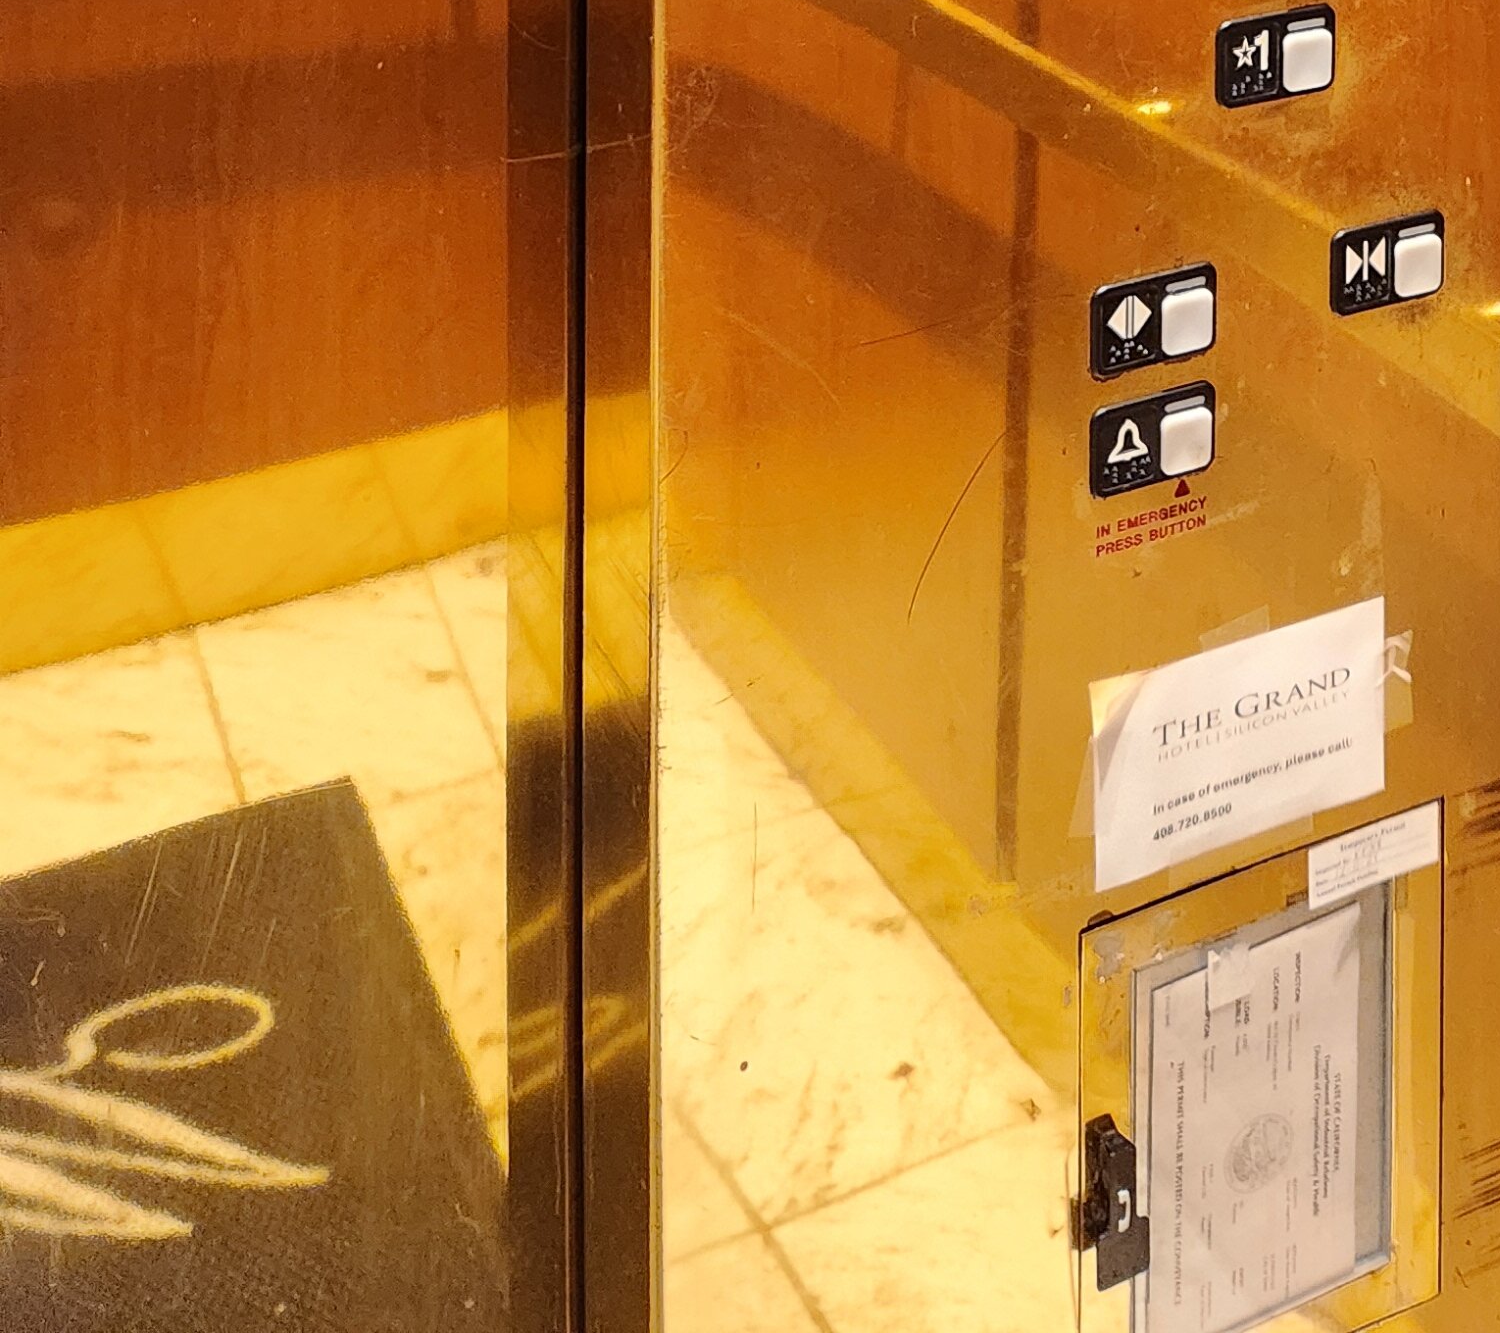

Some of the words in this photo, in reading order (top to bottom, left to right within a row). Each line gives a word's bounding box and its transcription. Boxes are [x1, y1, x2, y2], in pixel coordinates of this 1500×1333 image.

[1095, 533, 1144, 559] PRESS
[1148, 513, 1207, 542] BUTTON
[1096, 522, 1111, 540] IN
[1116, 495, 1208, 534] EMERGENCY
[1152, 709, 1221, 747] THE
[1234, 667, 1350, 719] GRAND
[1224, 710, 1287, 740] SILICON
[1291, 690, 1350, 718] VALLEY
[1153, 802, 1164, 816] In
[1167, 791, 1195, 810] case
[1198, 782, 1210, 799] of
[1213, 761, 1282, 794] emergency,
[1285, 745, 1325, 770] please
